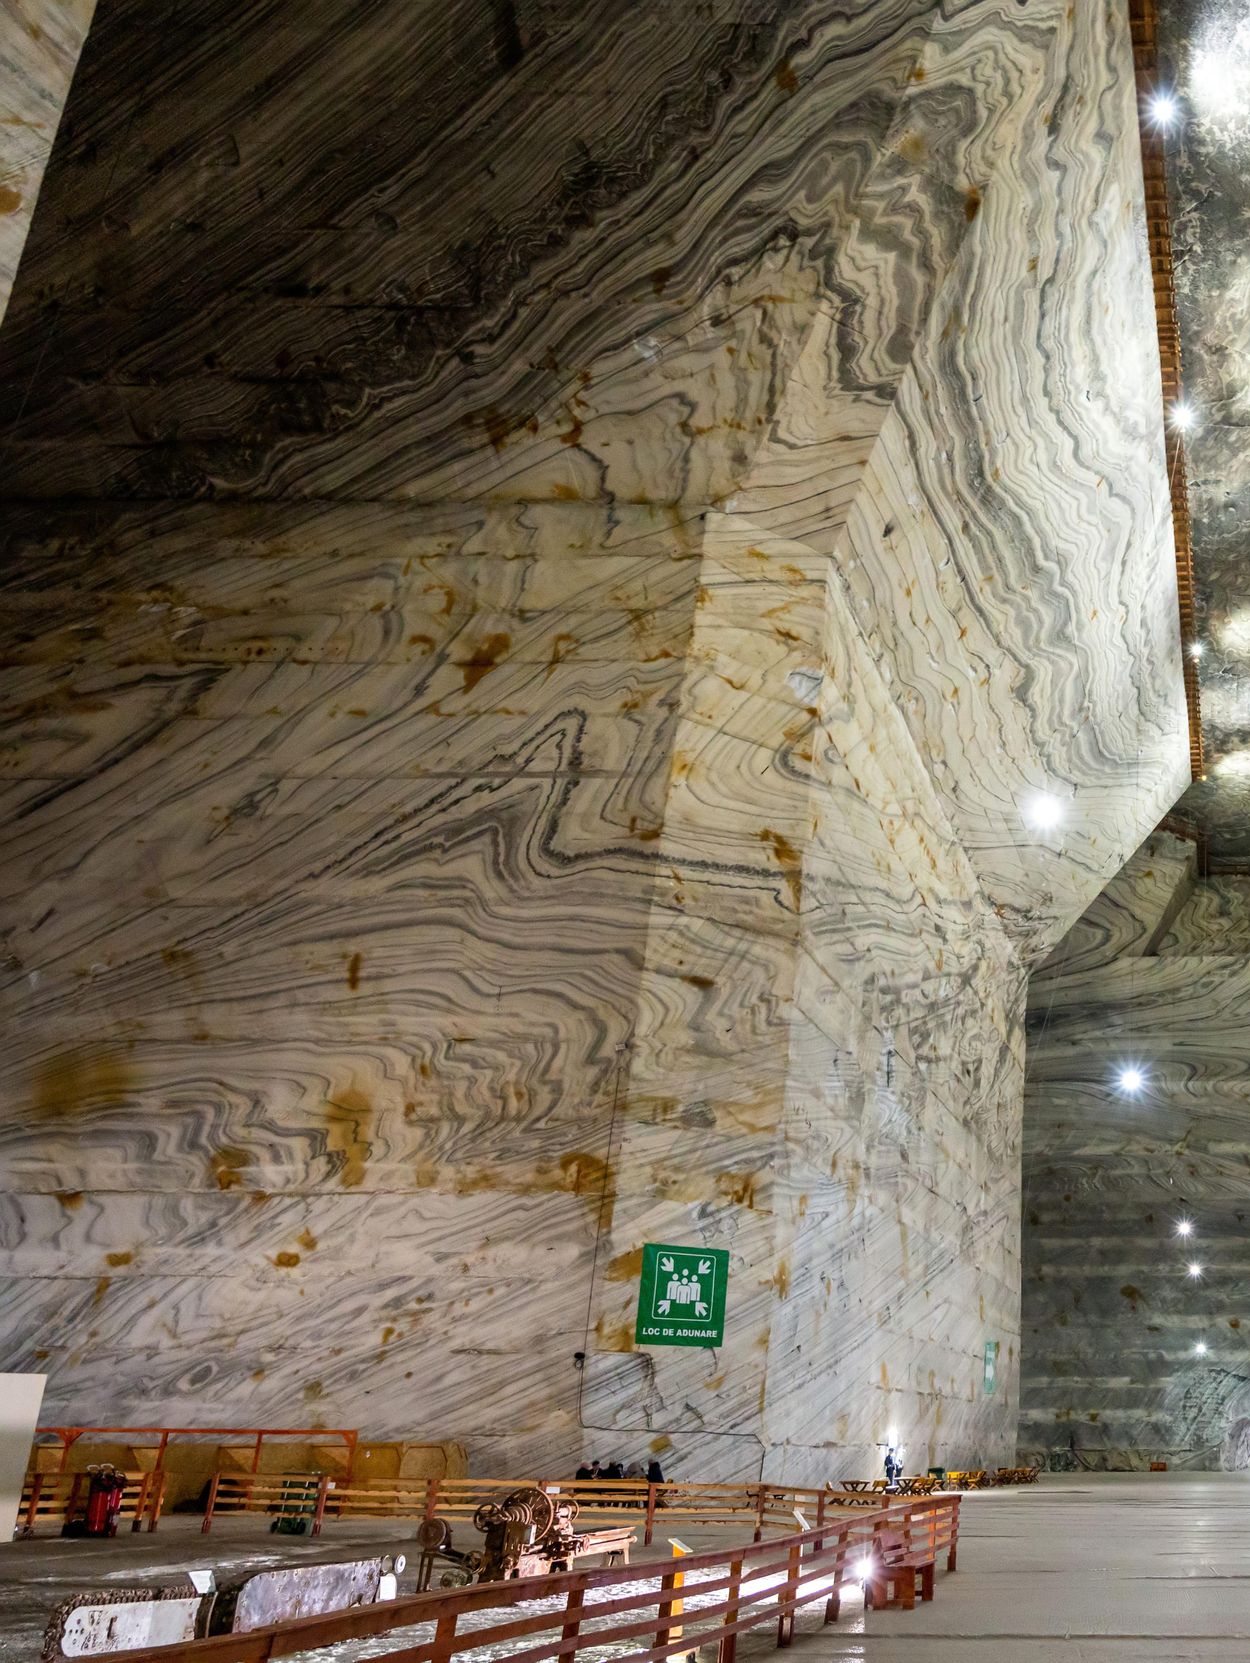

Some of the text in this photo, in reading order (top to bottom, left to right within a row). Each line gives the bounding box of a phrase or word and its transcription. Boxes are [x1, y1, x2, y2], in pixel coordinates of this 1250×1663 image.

[642, 1327, 718, 1338] LOC DE ADUNARE
